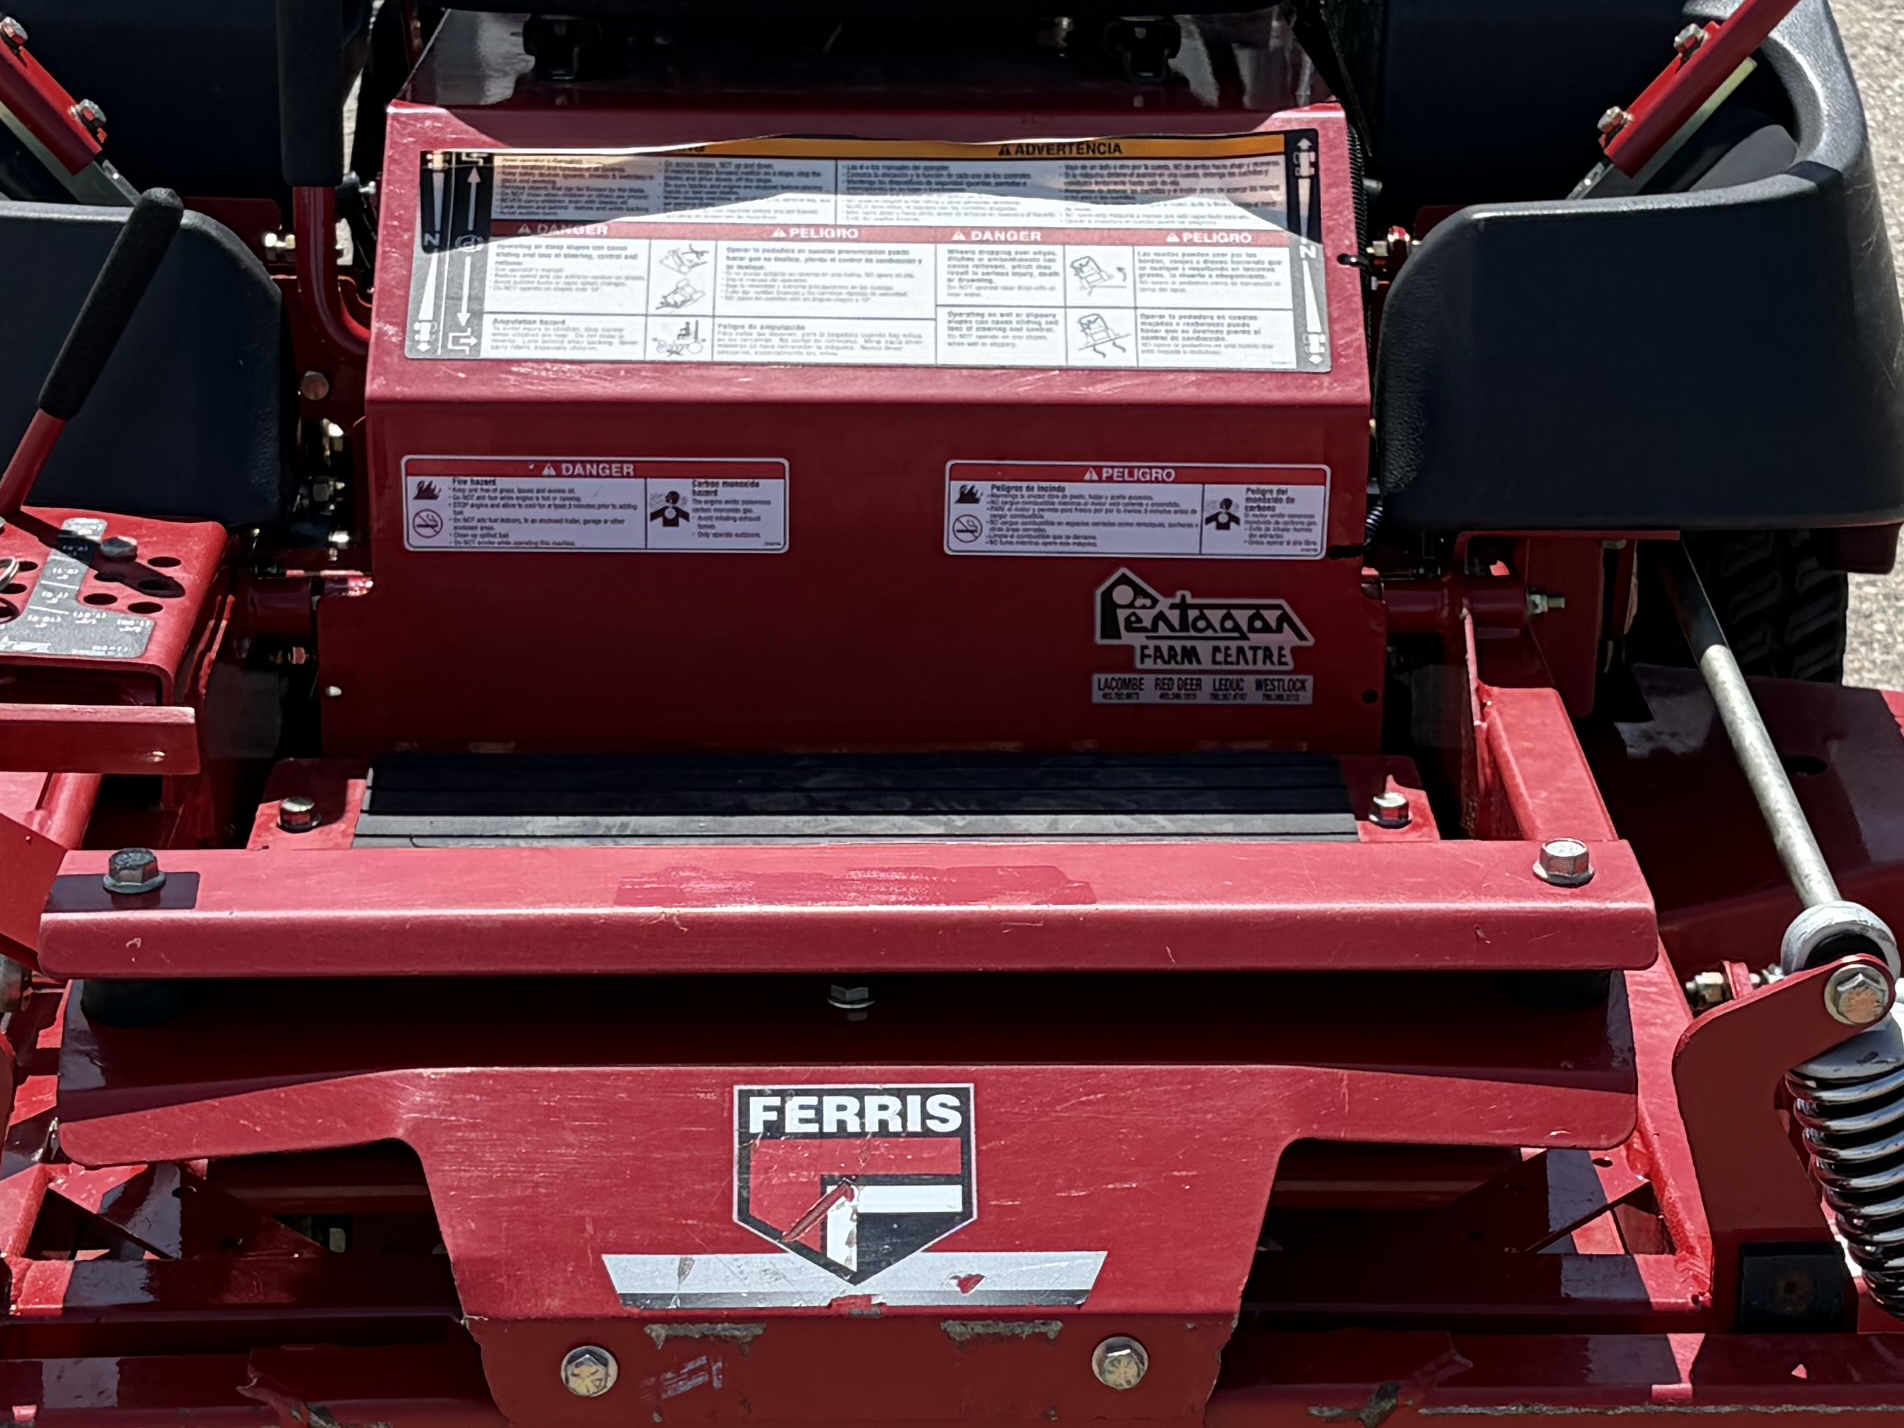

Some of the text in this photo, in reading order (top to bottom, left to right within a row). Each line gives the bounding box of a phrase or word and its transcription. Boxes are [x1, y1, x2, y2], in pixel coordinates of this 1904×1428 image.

[1014, 142, 1123, 157] ADVERTENCIA
[536, 222, 609, 237] DANGER
[788, 227, 860, 240] PELIGRO
[969, 230, 1043, 242] DANGER
[1182, 231, 1253, 244] PELIGRO
[561, 462, 635, 477] DANGER
[1101, 467, 1177, 483] PELIGRO
[1100, 572, 1308, 641] Pentagon
[1140, 645, 1289, 666] FARM CENTRE
[1098, 677, 1145, 692] LACOMBE
[1154, 677, 1202, 691] RED DEER
[1212, 678, 1245, 692] LEDUC
[1255, 678, 1308, 692] WESTLOCK
[747, 1094, 963, 1134] FERRIS
